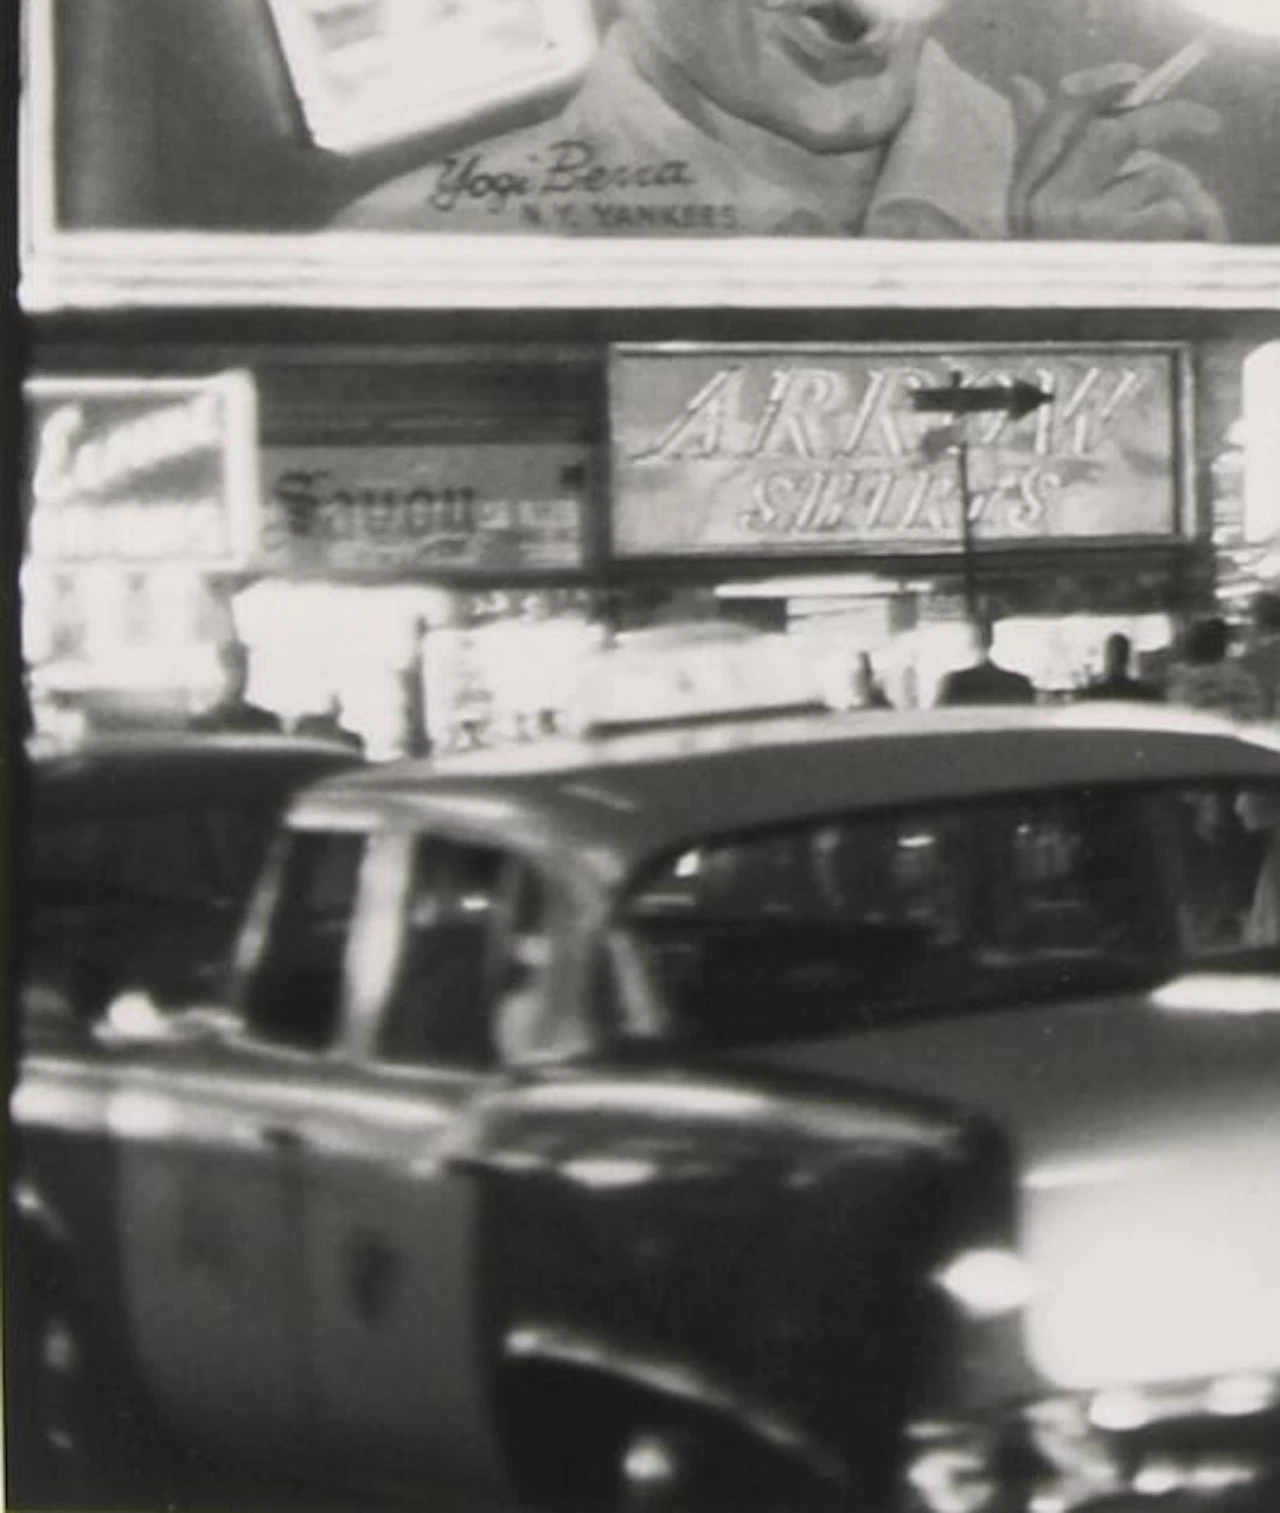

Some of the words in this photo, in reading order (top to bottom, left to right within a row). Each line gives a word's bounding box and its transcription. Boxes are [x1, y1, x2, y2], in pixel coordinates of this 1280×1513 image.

[427, 152, 540, 216] Yogi
[539, 138, 698, 195] Berra
[590, 203, 739, 232] YANKEES
